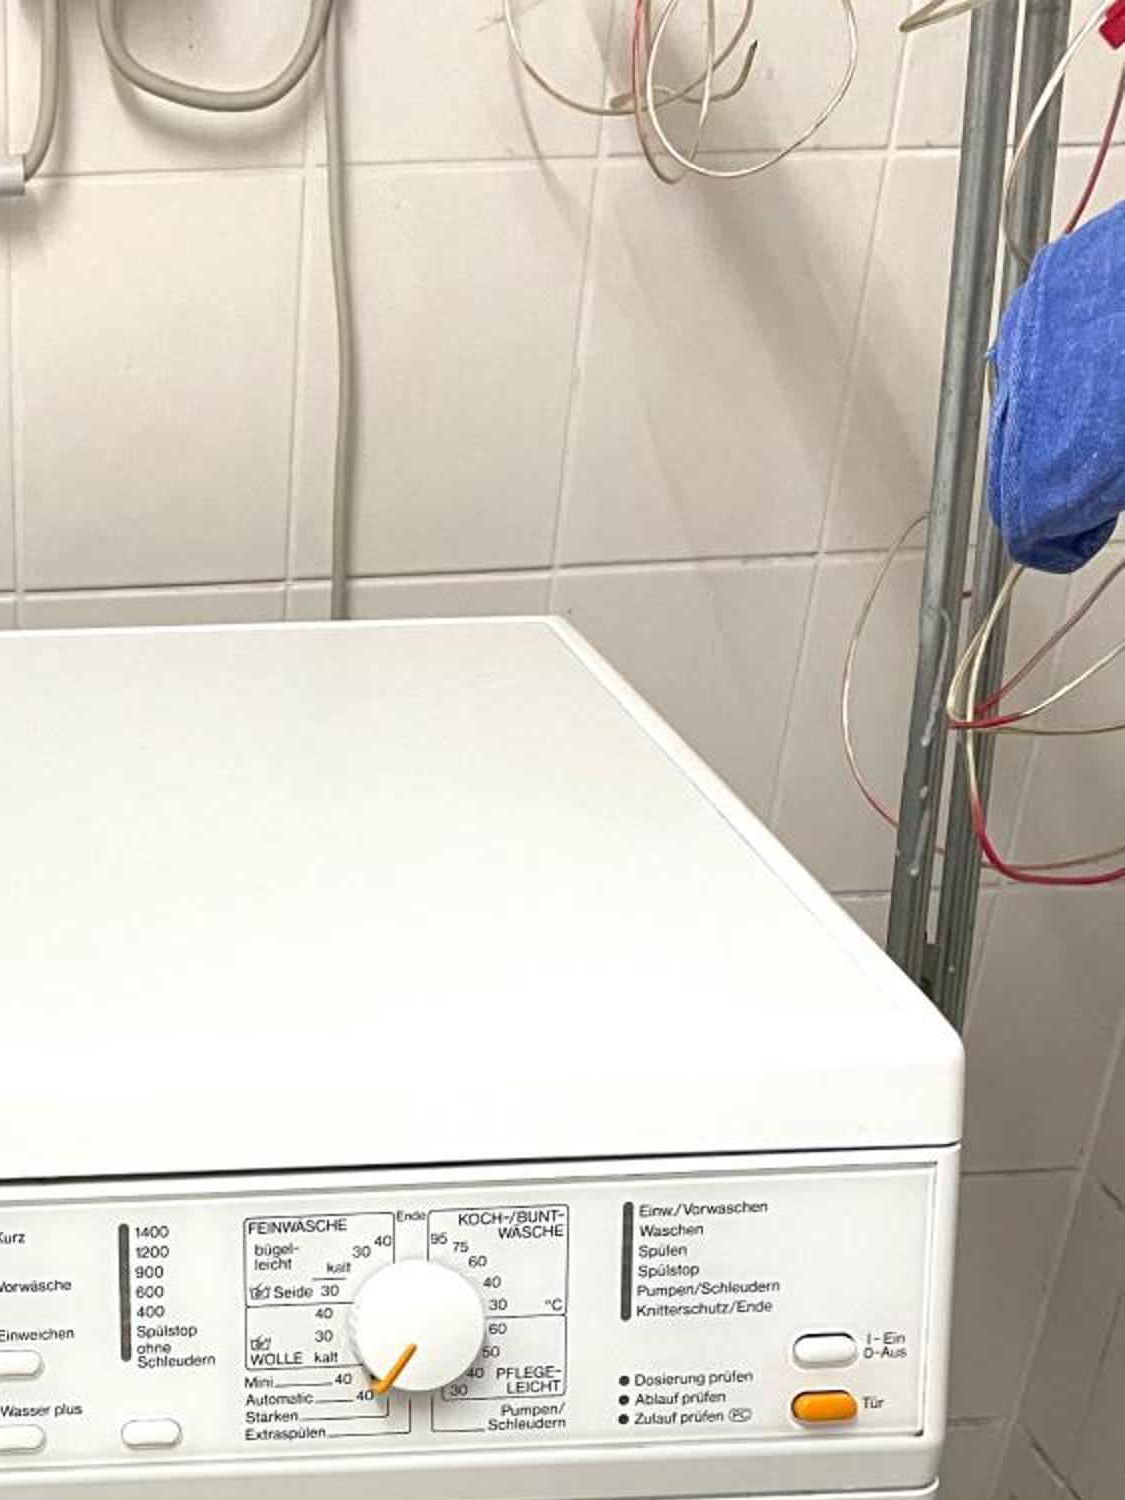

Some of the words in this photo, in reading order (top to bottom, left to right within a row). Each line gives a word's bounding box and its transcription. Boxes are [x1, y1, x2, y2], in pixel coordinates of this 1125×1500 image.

[396, 1210, 426, 1222] Ende
[135, 1225, 169, 1238] 1400
[498, 1223, 564, 1239] WÄSCHE
[639, 1224, 704, 1237] Waschen
[374, 1235, 392, 1247] 40
[430, 1232, 448, 1245] 95
[135, 1245, 169, 1258] 1200
[352, 1245, 372, 1258] 30
[452, 1241, 469, 1253] 75
[638, 1245, 688, 1258] Spülen
[254, 1257, 292, 1271] leicht
[326, 1261, 352, 1274] kalt
[468, 1255, 488, 1268] 60
[135, 1265, 164, 1278] 900
[638, 1264, 700, 1278] Spülstop
[482, 1275, 502, 1288] 40
[136, 1285, 164, 1298] 600
[273, 1285, 313, 1299] Seide
[320, 1284, 340, 1297] 30
[636, 1281, 780, 1297] Pumpen/Schleudern
[488, 1298, 508, 1311] 30
[636, 1300, 773, 1317] Knitterschutz/Ende
[136, 1305, 166, 1318] 400
[314, 1307, 334, 1319] 40
[136, 1325, 198, 1339] Spülstop
[488, 1322, 507, 1335] 60
[314, 1329, 333, 1343] 30
[136, 1343, 172, 1354] ohne
[482, 1346, 500, 1359] 50
[137, 1354, 216, 1369] Schleudern
[250, 1352, 304, 1365] WOLLE
[314, 1351, 339, 1364] kalt
[334, 1373, 352, 1385] 40
[466, 1367, 485, 1379] 40
[496, 1365, 562, 1380] PFLEGE-
[634, 1372, 706, 1386] Dosierung
[708, 1369, 754, 1386] prüfen
[244, 1375, 274, 1389] Mini
[506, 1379, 561, 1394] LEICHT
[356, 1389, 374, 1401] 40
[449, 1383, 468, 1396] 30
[245, 1392, 314, 1406] Automatic
[635, 1391, 679, 1406] Ablauf
[682, 1390, 726, 1406] prüfen
[862, 1396, 885, 1409] Tür
[0, 1404, 50, 1418] Wasser
[54, 1403, 83, 1418] plus
[500, 1402, 566, 1416] Pumpen/
[635, 1411, 677, 1424] Zulauf
[680, 1409, 724, 1425] prüfen
[488, 1417, 566, 1432] Schleudern
[244, 1426, 326, 1441] Extraspülen
